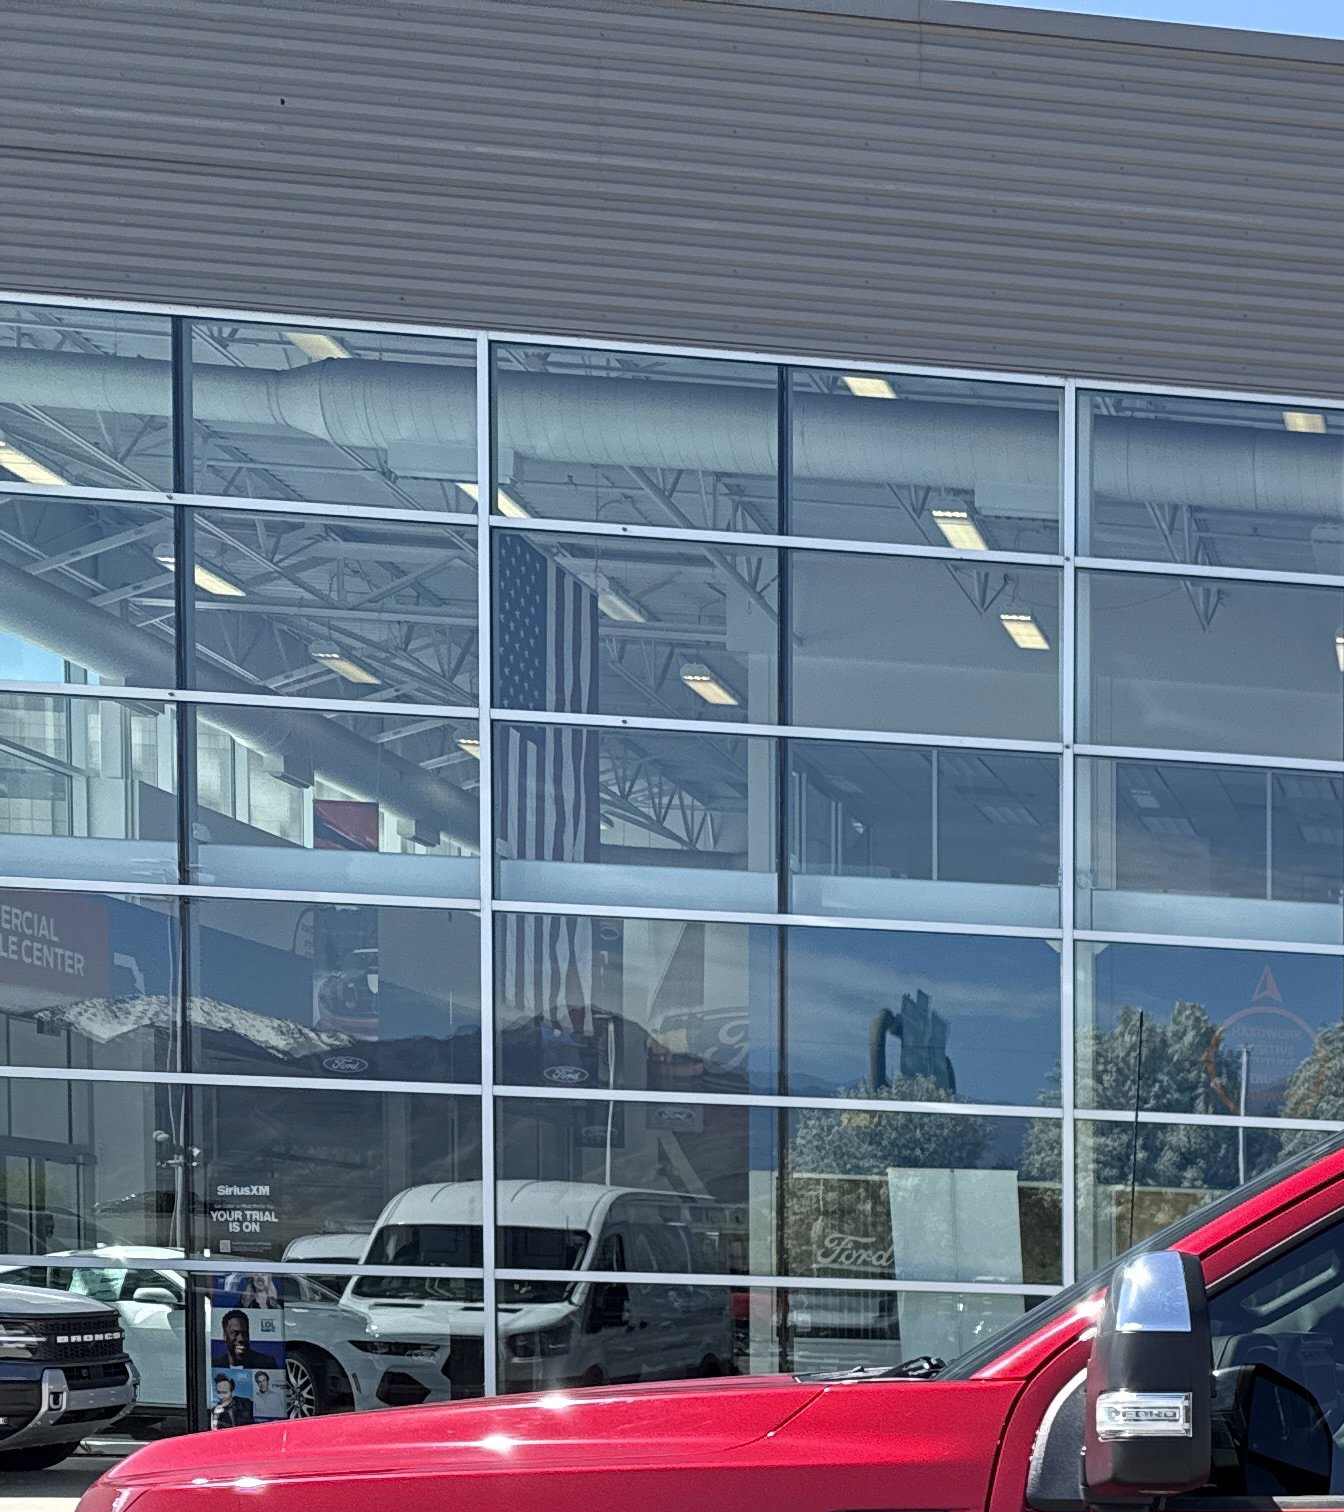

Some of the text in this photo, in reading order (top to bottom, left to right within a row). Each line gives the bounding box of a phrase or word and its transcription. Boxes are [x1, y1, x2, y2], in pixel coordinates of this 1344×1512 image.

[0, 904, 60, 943] ERCIAL
[21, 939, 85, 977] CENTER
[328, 1056, 364, 1073] Ford
[547, 1066, 584, 1083] Ford
[217, 1184, 270, 1196] SiriusXM
[210, 1210, 279, 1222] YOUR TRIAL
[228, 1221, 260, 1233] IS ON
[816, 1233, 894, 1267] Ford
